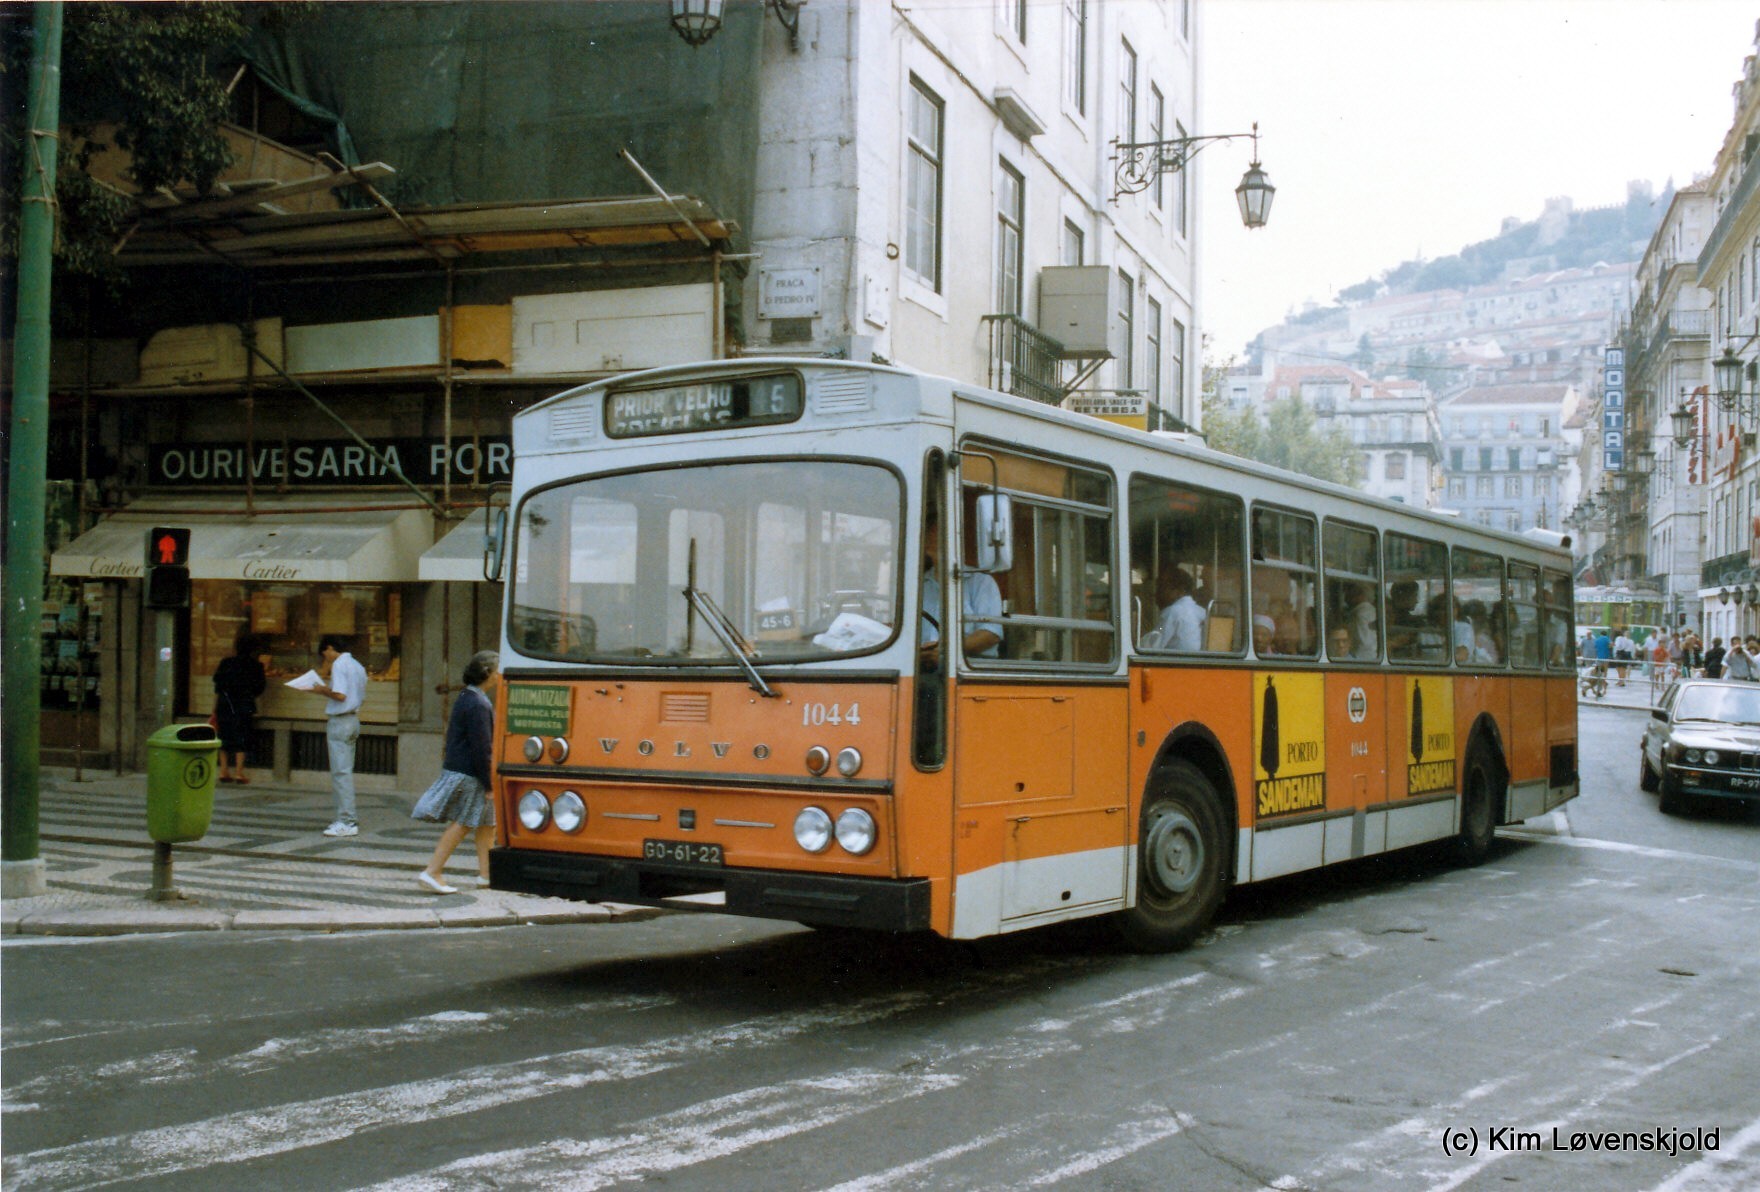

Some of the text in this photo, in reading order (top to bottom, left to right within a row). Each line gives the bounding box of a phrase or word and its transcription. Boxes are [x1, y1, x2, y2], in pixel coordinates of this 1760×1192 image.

[613, 393, 665, 418] PRIOR
[674, 383, 732, 411] VELHO
[1605, 349, 1624, 469] MONTAL
[161, 445, 401, 480] OURIVESARIA
[89, 556, 142, 576] Cartier
[242, 559, 301, 580] Cartier
[802, 703, 862, 727] 1044
[598, 737, 771, 760] VOLVO
[1287, 740, 1318, 764] PORTO
[1428, 733, 1450, 752] PORTO
[1409, 761, 1454, 794] SANDEMAN
[1258, 774, 1323, 817] SANDEMAN
[644, 841, 721, 864] GO-61-22
